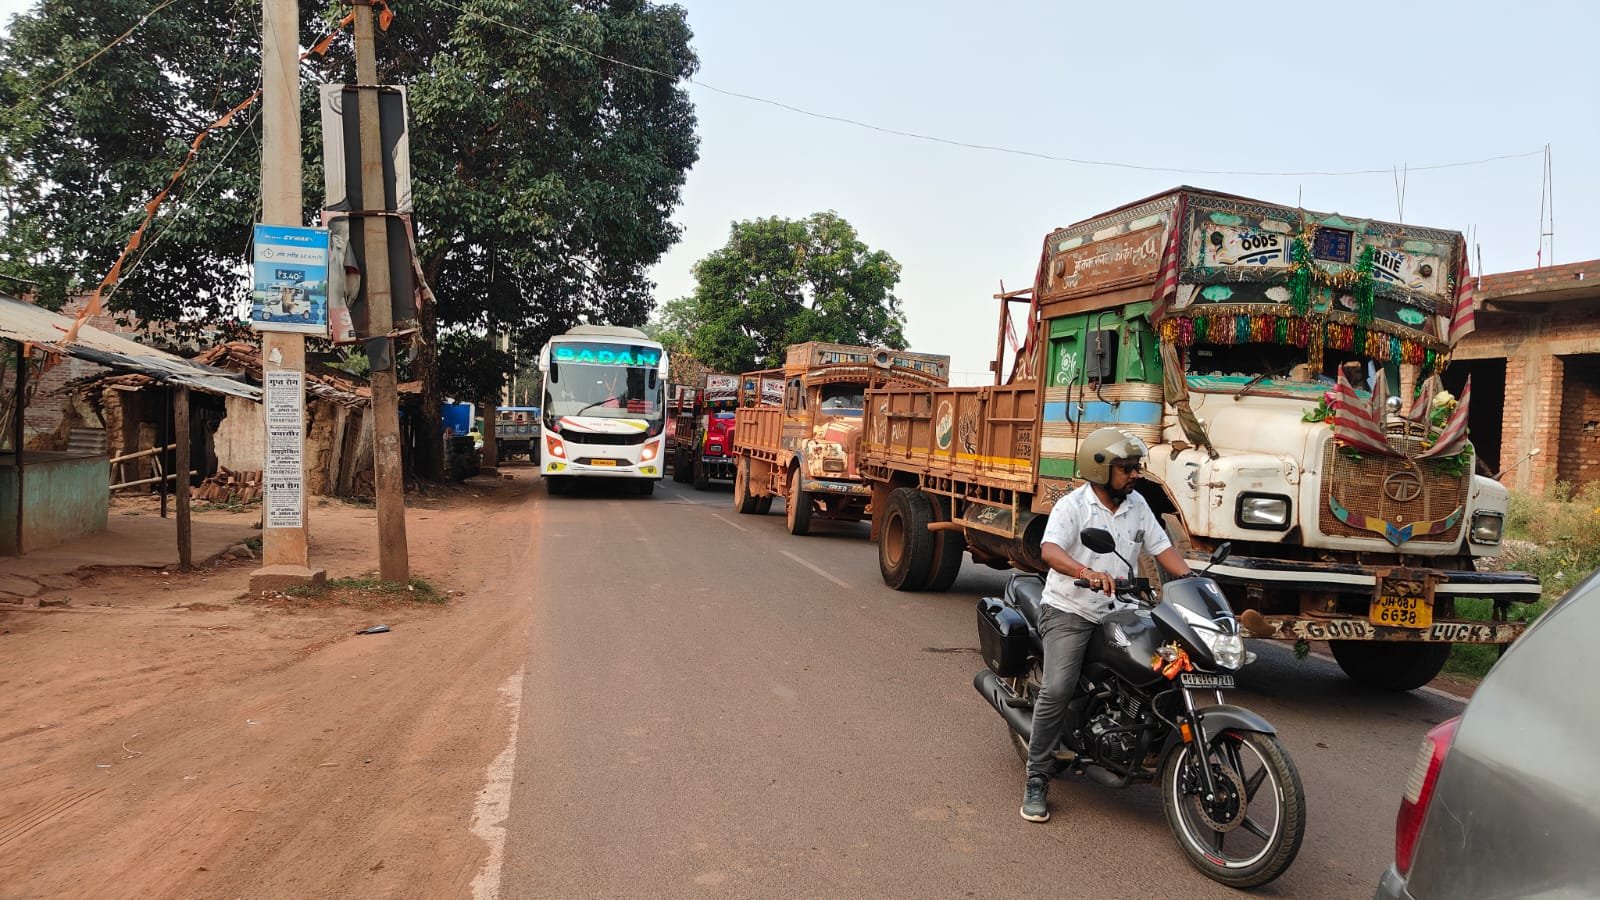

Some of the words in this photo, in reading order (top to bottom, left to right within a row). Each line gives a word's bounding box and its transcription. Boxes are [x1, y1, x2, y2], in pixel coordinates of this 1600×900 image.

[1374, 248, 1402, 273] RRIE
[1381, 609, 1417, 624] 6638
[1305, 621, 1367, 639] GOOD
[1430, 624, 1483, 642] LUCK
